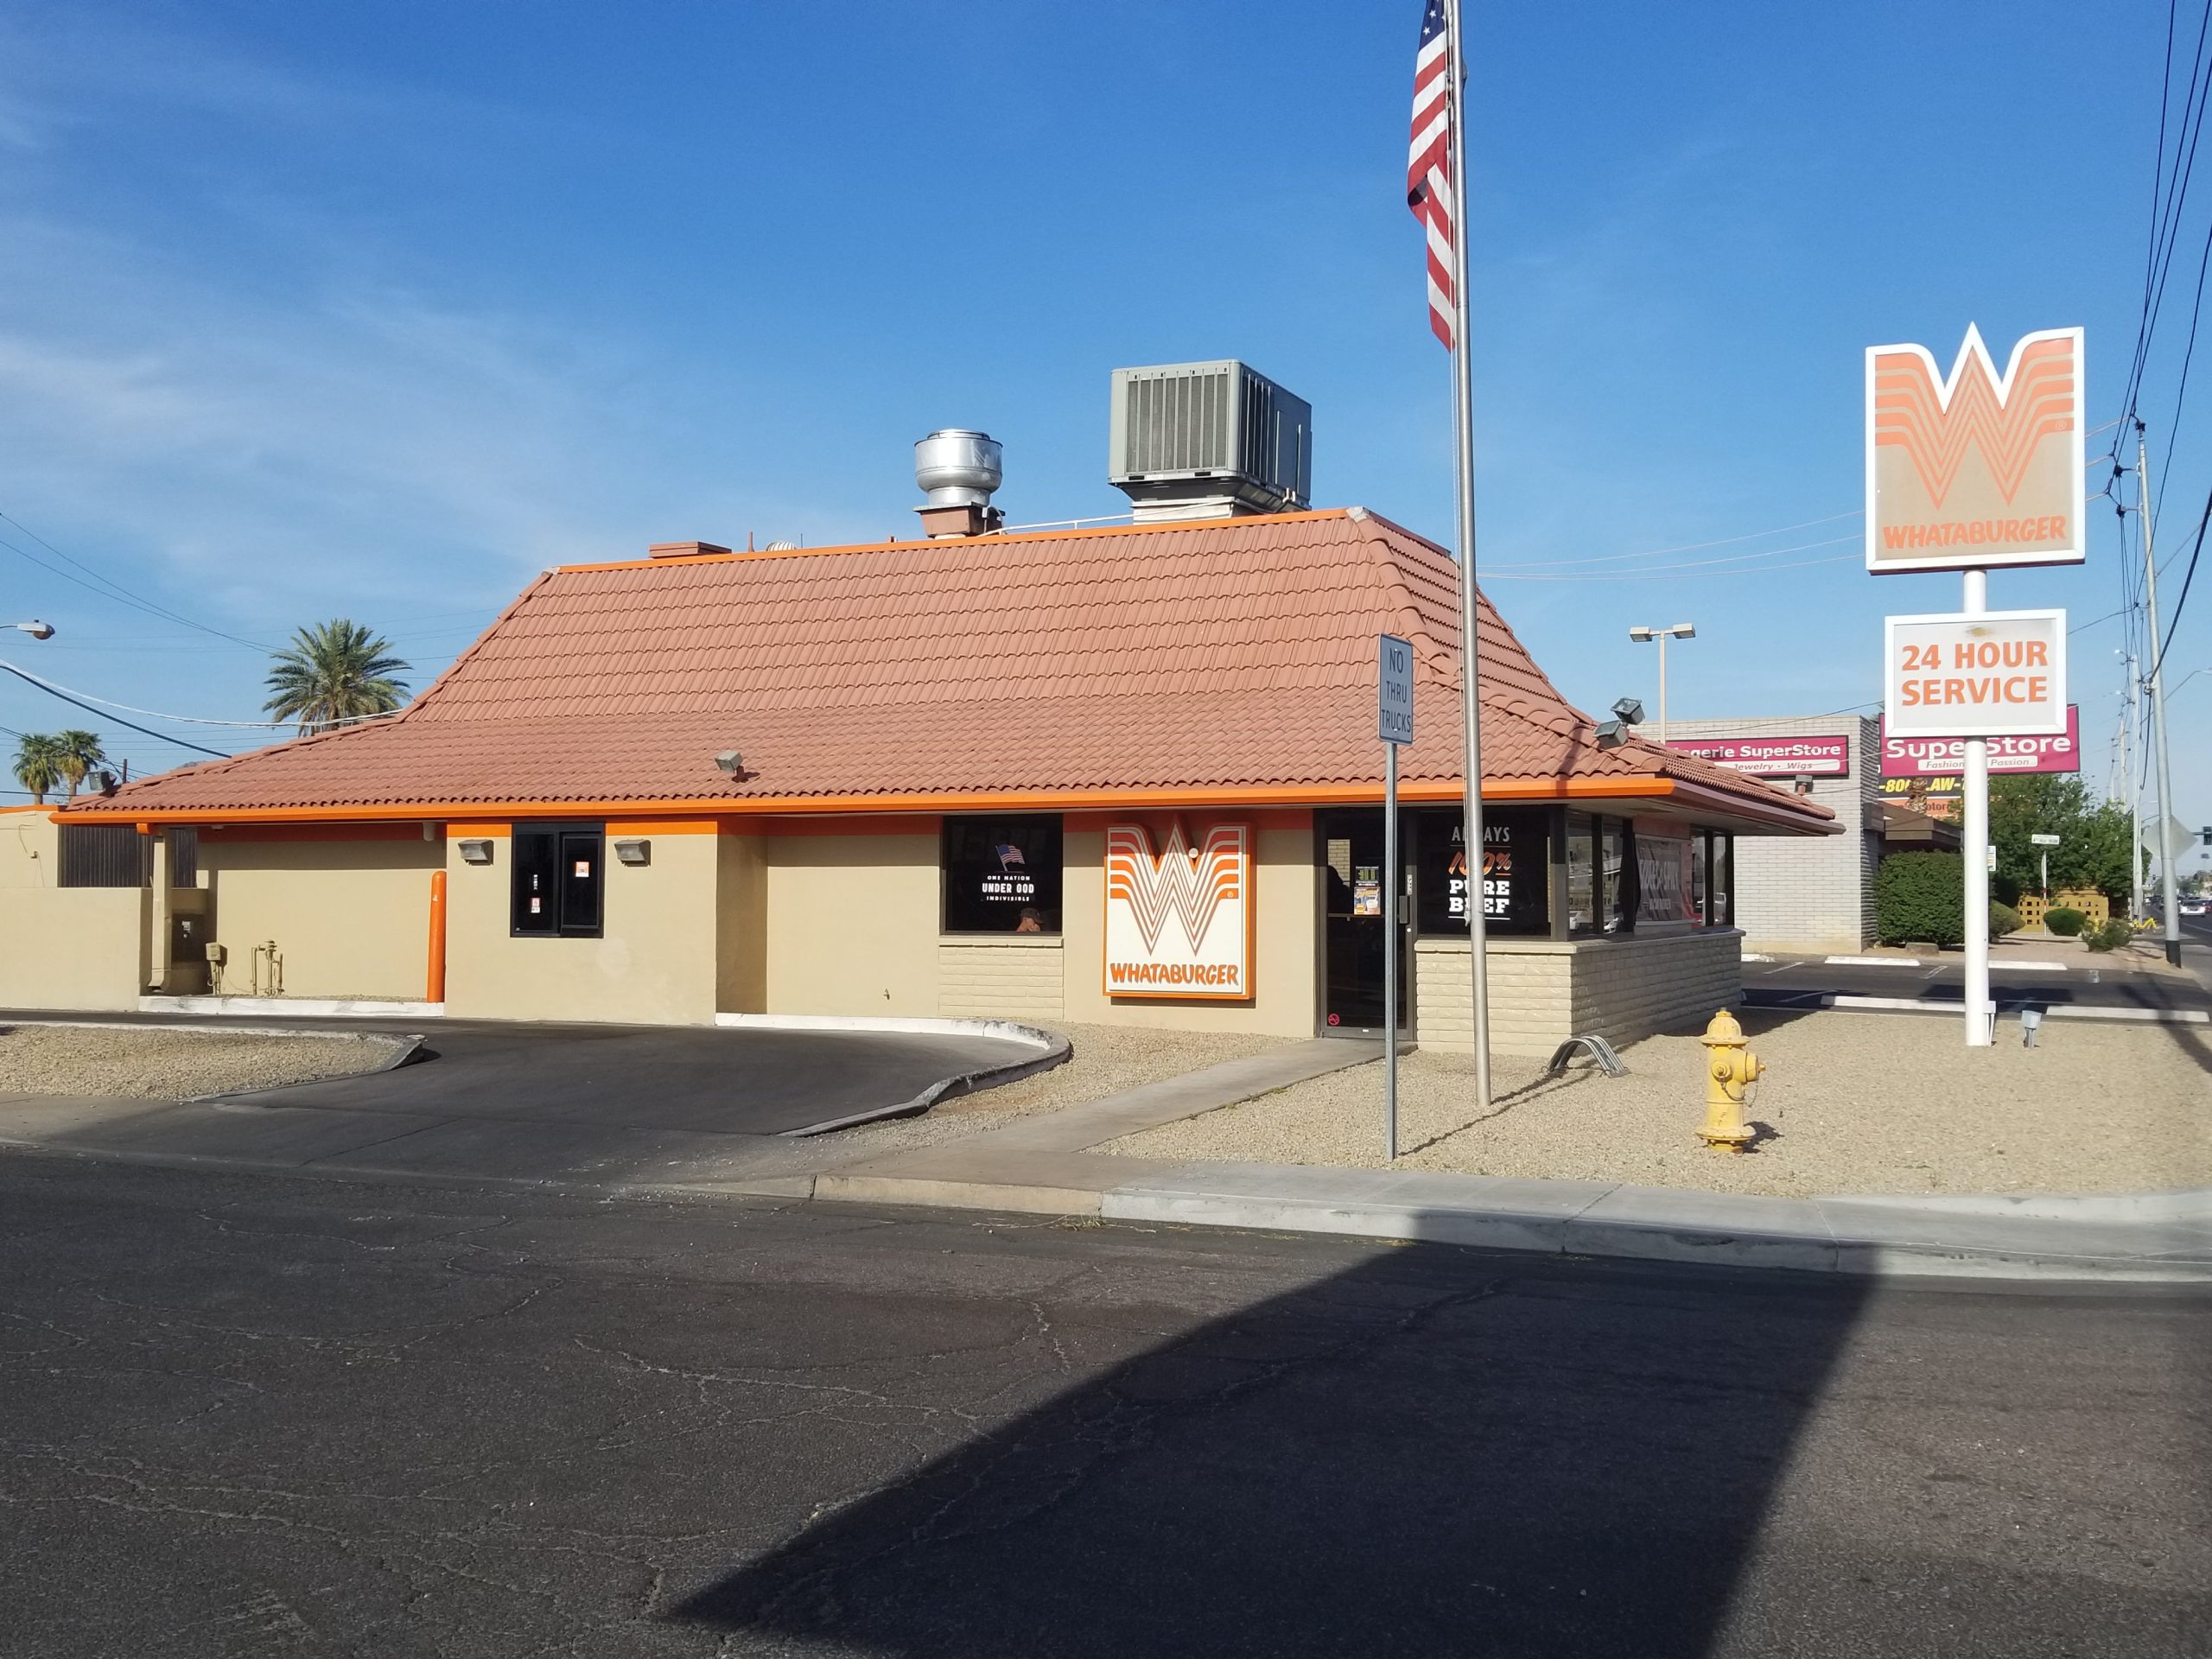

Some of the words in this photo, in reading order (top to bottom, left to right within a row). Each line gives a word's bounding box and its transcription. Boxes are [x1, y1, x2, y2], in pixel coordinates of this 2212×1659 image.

[1882, 515, 2068, 550] WHATABURGER
[1389, 647, 1404, 674] NO
[1902, 644, 1942, 671] 24
[1955, 640, 2049, 670] HOUR
[1386, 680, 1408, 704] THRU
[1902, 676, 2048, 707] SERVICE
[1381, 709, 1412, 734] TRUCKS
[1739, 743, 1841, 760] SuperStore
[1886, 736, 2071, 760] SupeStore
[1734, 763, 1773, 772] Jewelry
[1787, 761, 1813, 771] Wigs
[1990, 758, 2030, 767] Passion
[1452, 826, 1510, 842] AAYS
[982, 882, 1012, 893] UNDER
[1016, 883, 1034, 893] GOD
[1449, 880, 1510, 895] PRE
[1449, 897, 1510, 913] BEF
[1109, 963, 1239, 986] WHATABURGER
